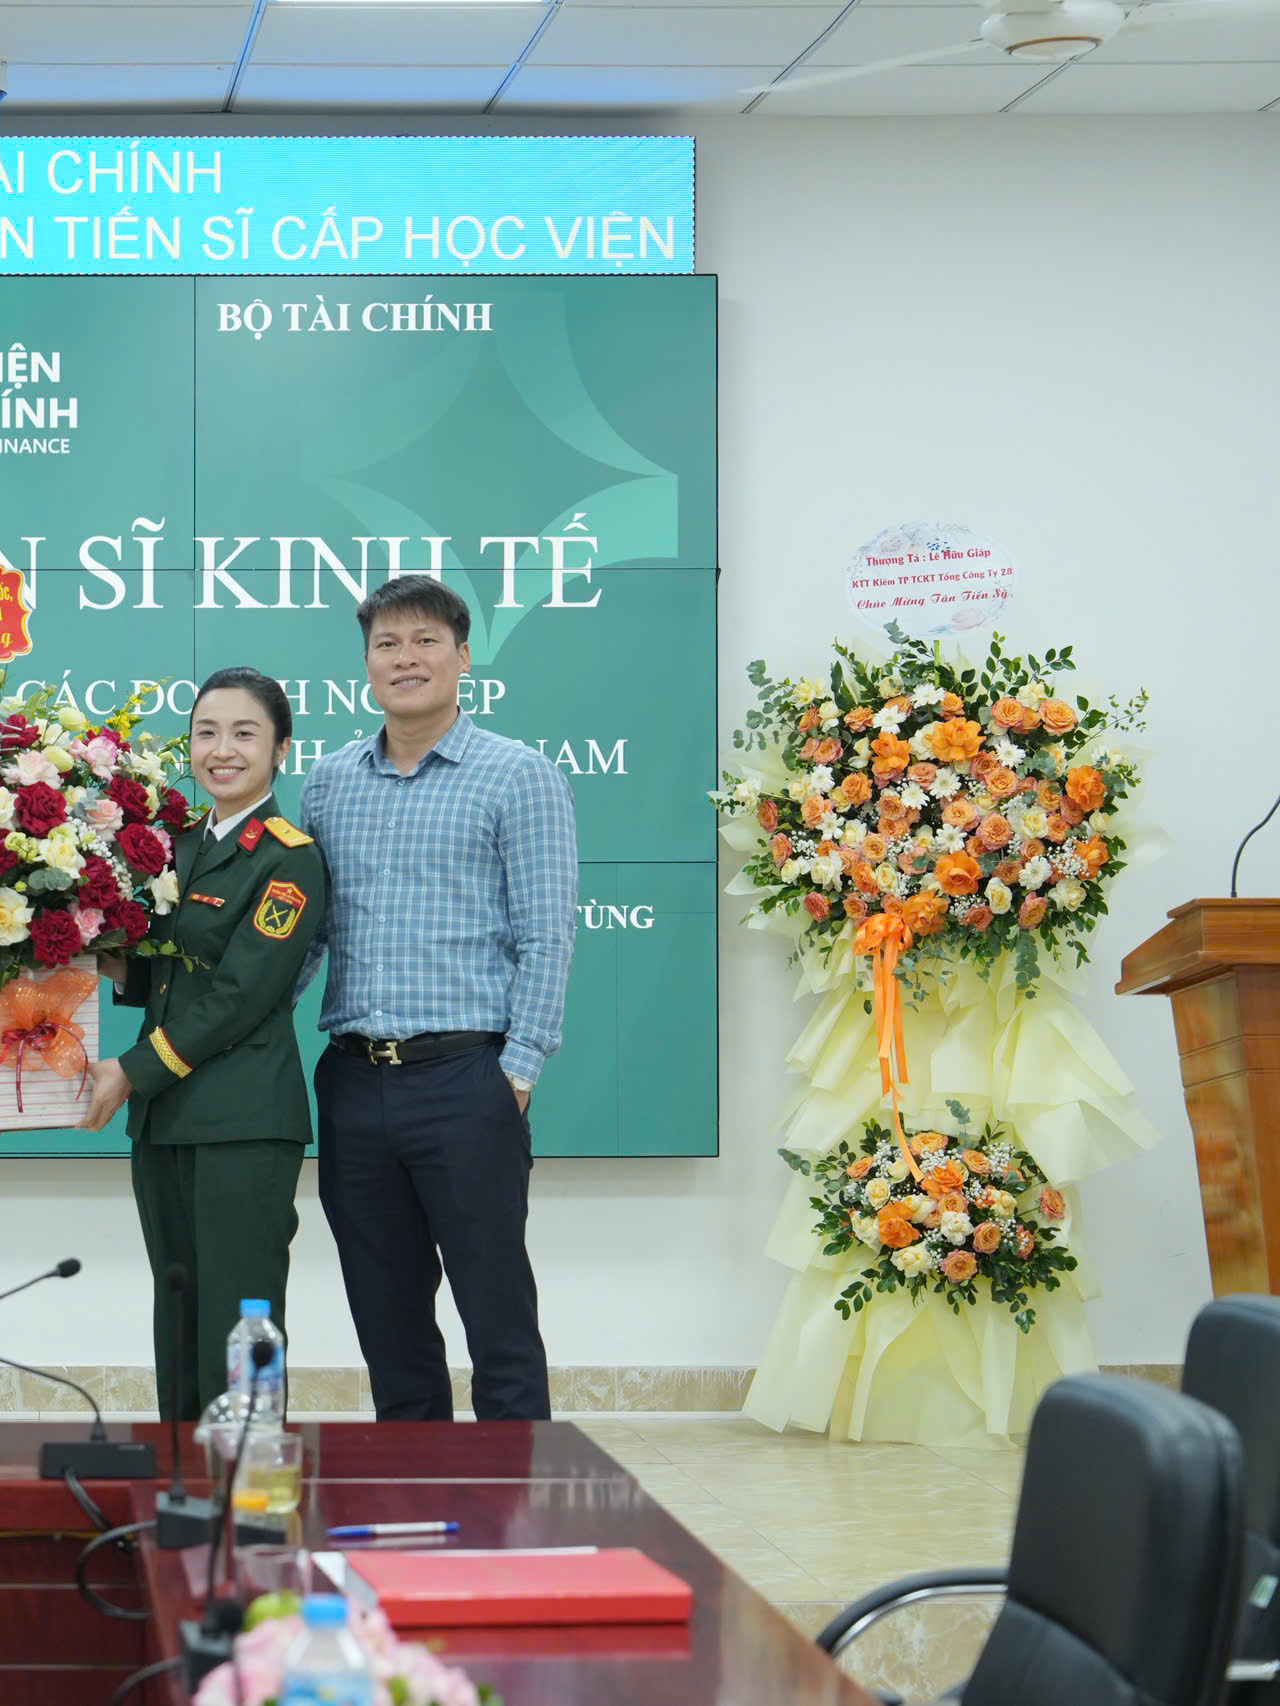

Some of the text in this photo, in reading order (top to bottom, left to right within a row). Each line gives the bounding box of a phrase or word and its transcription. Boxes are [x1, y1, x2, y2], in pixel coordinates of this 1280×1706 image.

[47, 141, 222, 194] CHÍNH
[54, 206, 180, 260] TIẾN
[202, 208, 250, 260] SĨ
[272, 206, 384, 260] CẤP
[405, 215, 527, 268] HỌC
[546, 212, 675, 268] VIỆN
[217, 295, 494, 340] BỘ TÀI CHÍNH
[78, 514, 167, 610] SĨ
[194, 536, 452, 609] KINH
[479, 512, 603, 608] TẾ
[852, 579, 870, 588] KTT
[898, 576, 909, 585] TP
[912, 574, 936, 583] TCKT
[988, 568, 998, 577] Ty
[1001, 567, 1013, 576] 28
[866, 556, 904, 567] Thượng
[907, 553, 920, 563] Tá
[943, 550, 964, 561] Hữu
[967, 548, 992, 559] Giáp
[857, 599, 887, 609] Chúc
[890, 596, 925, 607] Mừng
